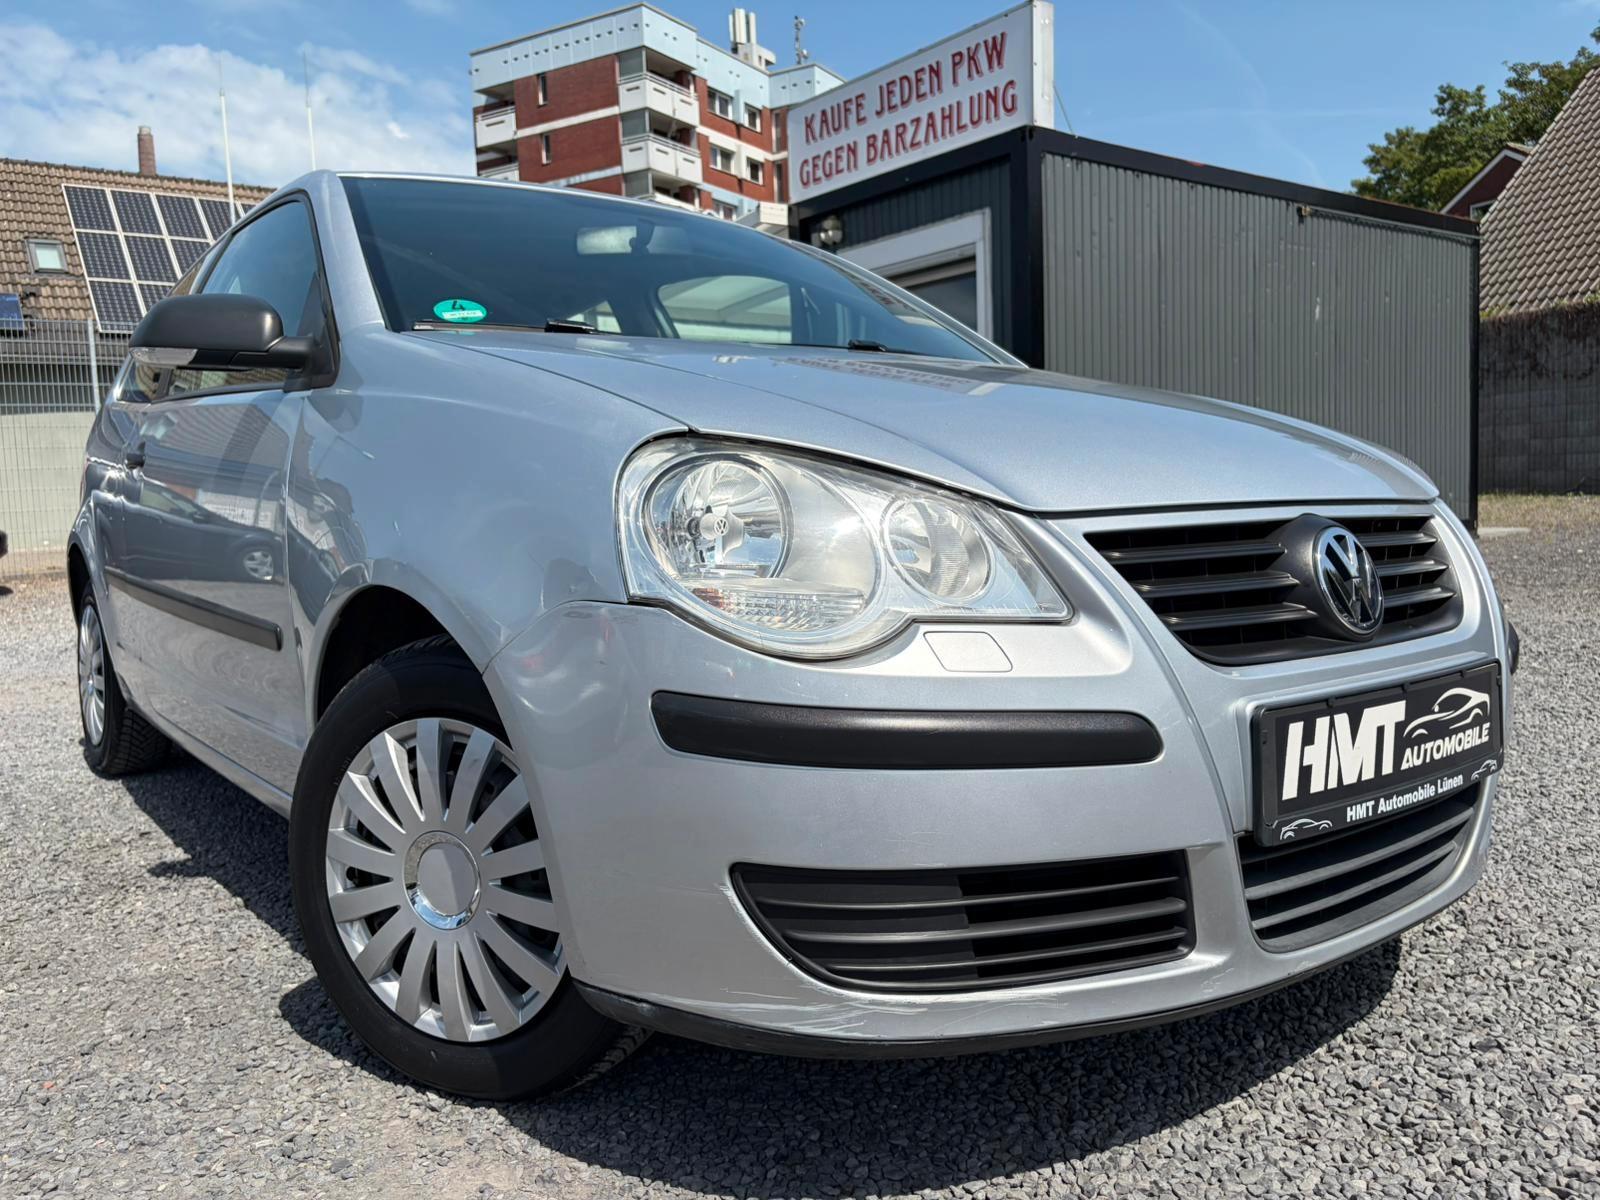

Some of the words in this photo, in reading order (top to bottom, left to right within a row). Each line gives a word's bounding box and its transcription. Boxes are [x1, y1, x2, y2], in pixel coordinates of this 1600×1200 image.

[800, 138, 859, 189] GEGEN
[866, 80, 1018, 166] BARZAHLUNG
[804, 92, 867, 145] KAUFE
[875, 59, 943, 118] JEDEN
[951, 31, 1008, 87] PKW
[1282, 700, 1406, 801] HMT
[1401, 722, 1490, 771] AUTOMOBILE
[1346, 800, 1374, 822] HMT
[1378, 784, 1435, 814] Automobile
[1437, 774, 1464, 794] Lünen
